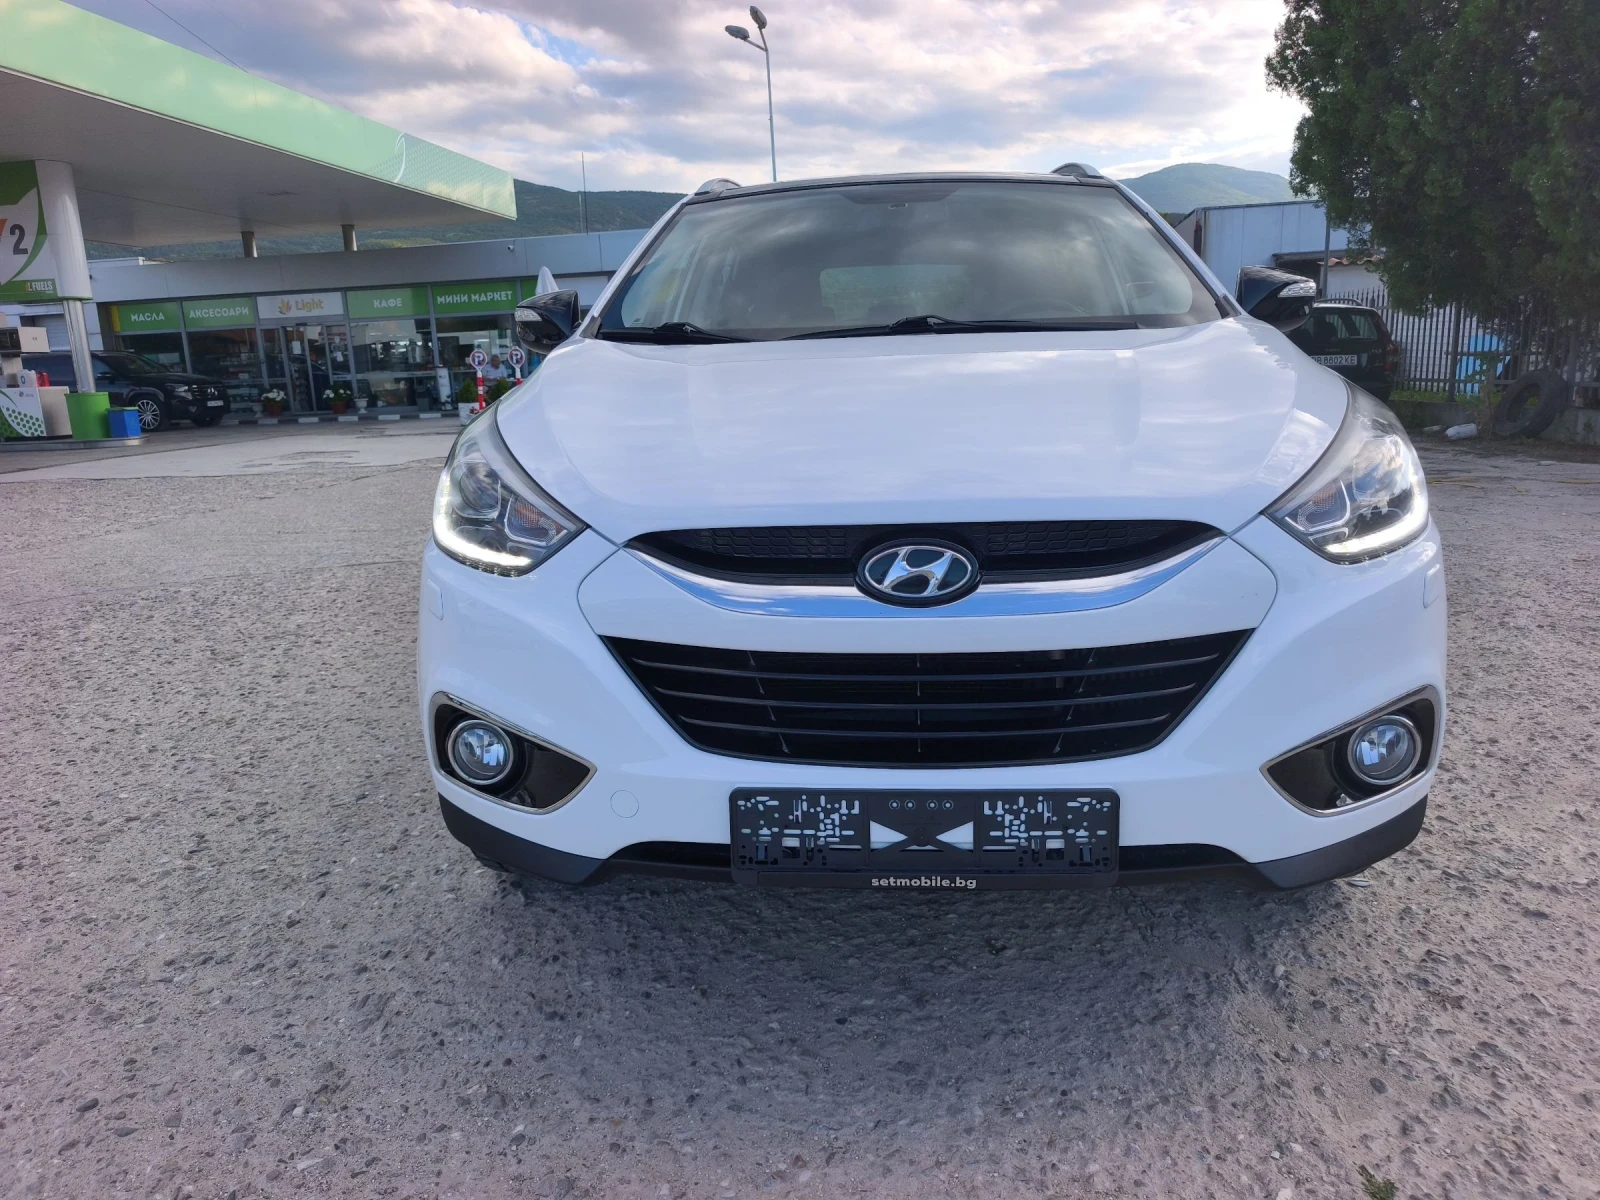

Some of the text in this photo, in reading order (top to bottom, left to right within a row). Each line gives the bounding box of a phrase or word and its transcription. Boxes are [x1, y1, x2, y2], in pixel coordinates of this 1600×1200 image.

[10, 224, 28, 255] 2
[32, 281, 53, 291] FUELS
[373, 298, 402, 308] КАФЕ
[437, 291, 513, 304] МИНИ МАРКЕТ
[295, 298, 324, 312] Light
[131, 312, 165, 322] МАСЛА
[189, 306, 249, 319] АКСЕСОАРИ
[871, 876, 977, 889] setmobile.bg
